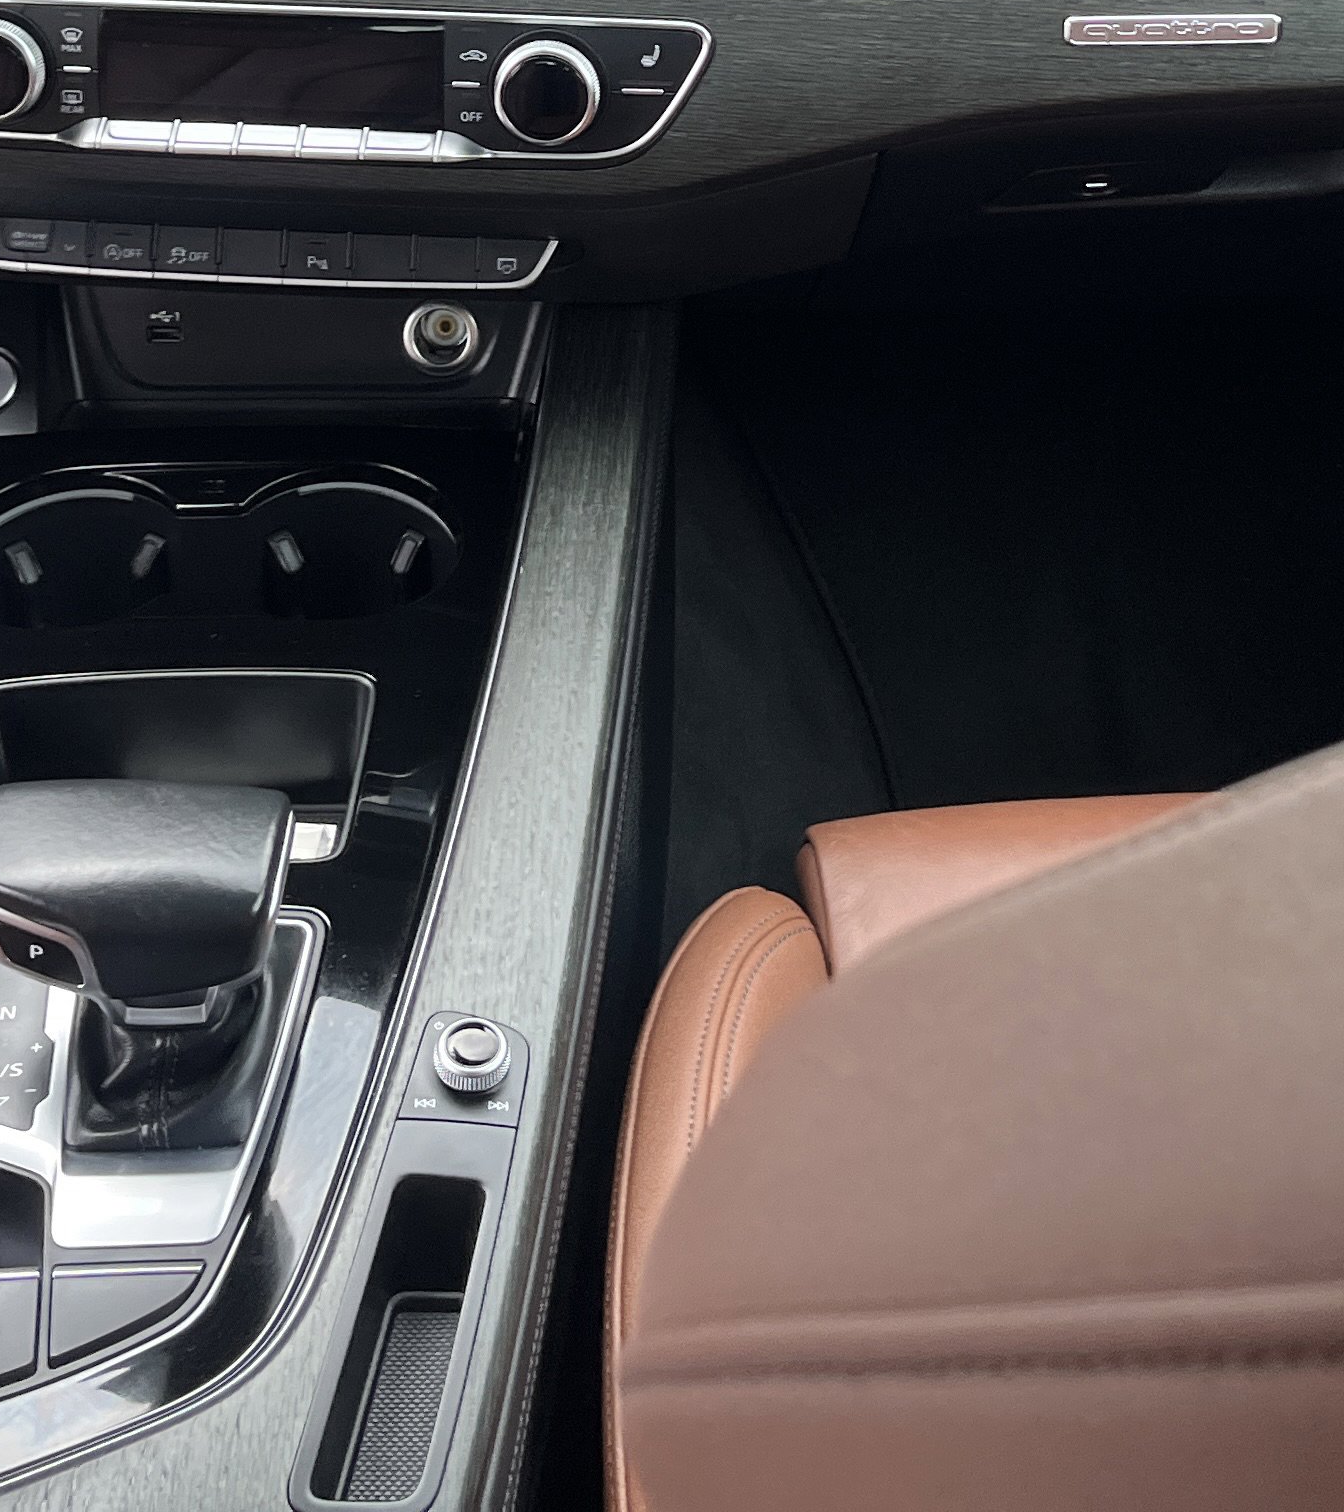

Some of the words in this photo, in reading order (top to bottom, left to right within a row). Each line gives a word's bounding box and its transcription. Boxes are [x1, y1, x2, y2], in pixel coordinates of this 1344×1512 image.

[1082, 19, 1265, 40] quattro
[459, 111, 483, 123] OFF
[123, 248, 144, 259] OFF
[189, 251, 210, 262] OFF
[28, 943, 44, 959] P
[0, 1005, 17, 1021] N
